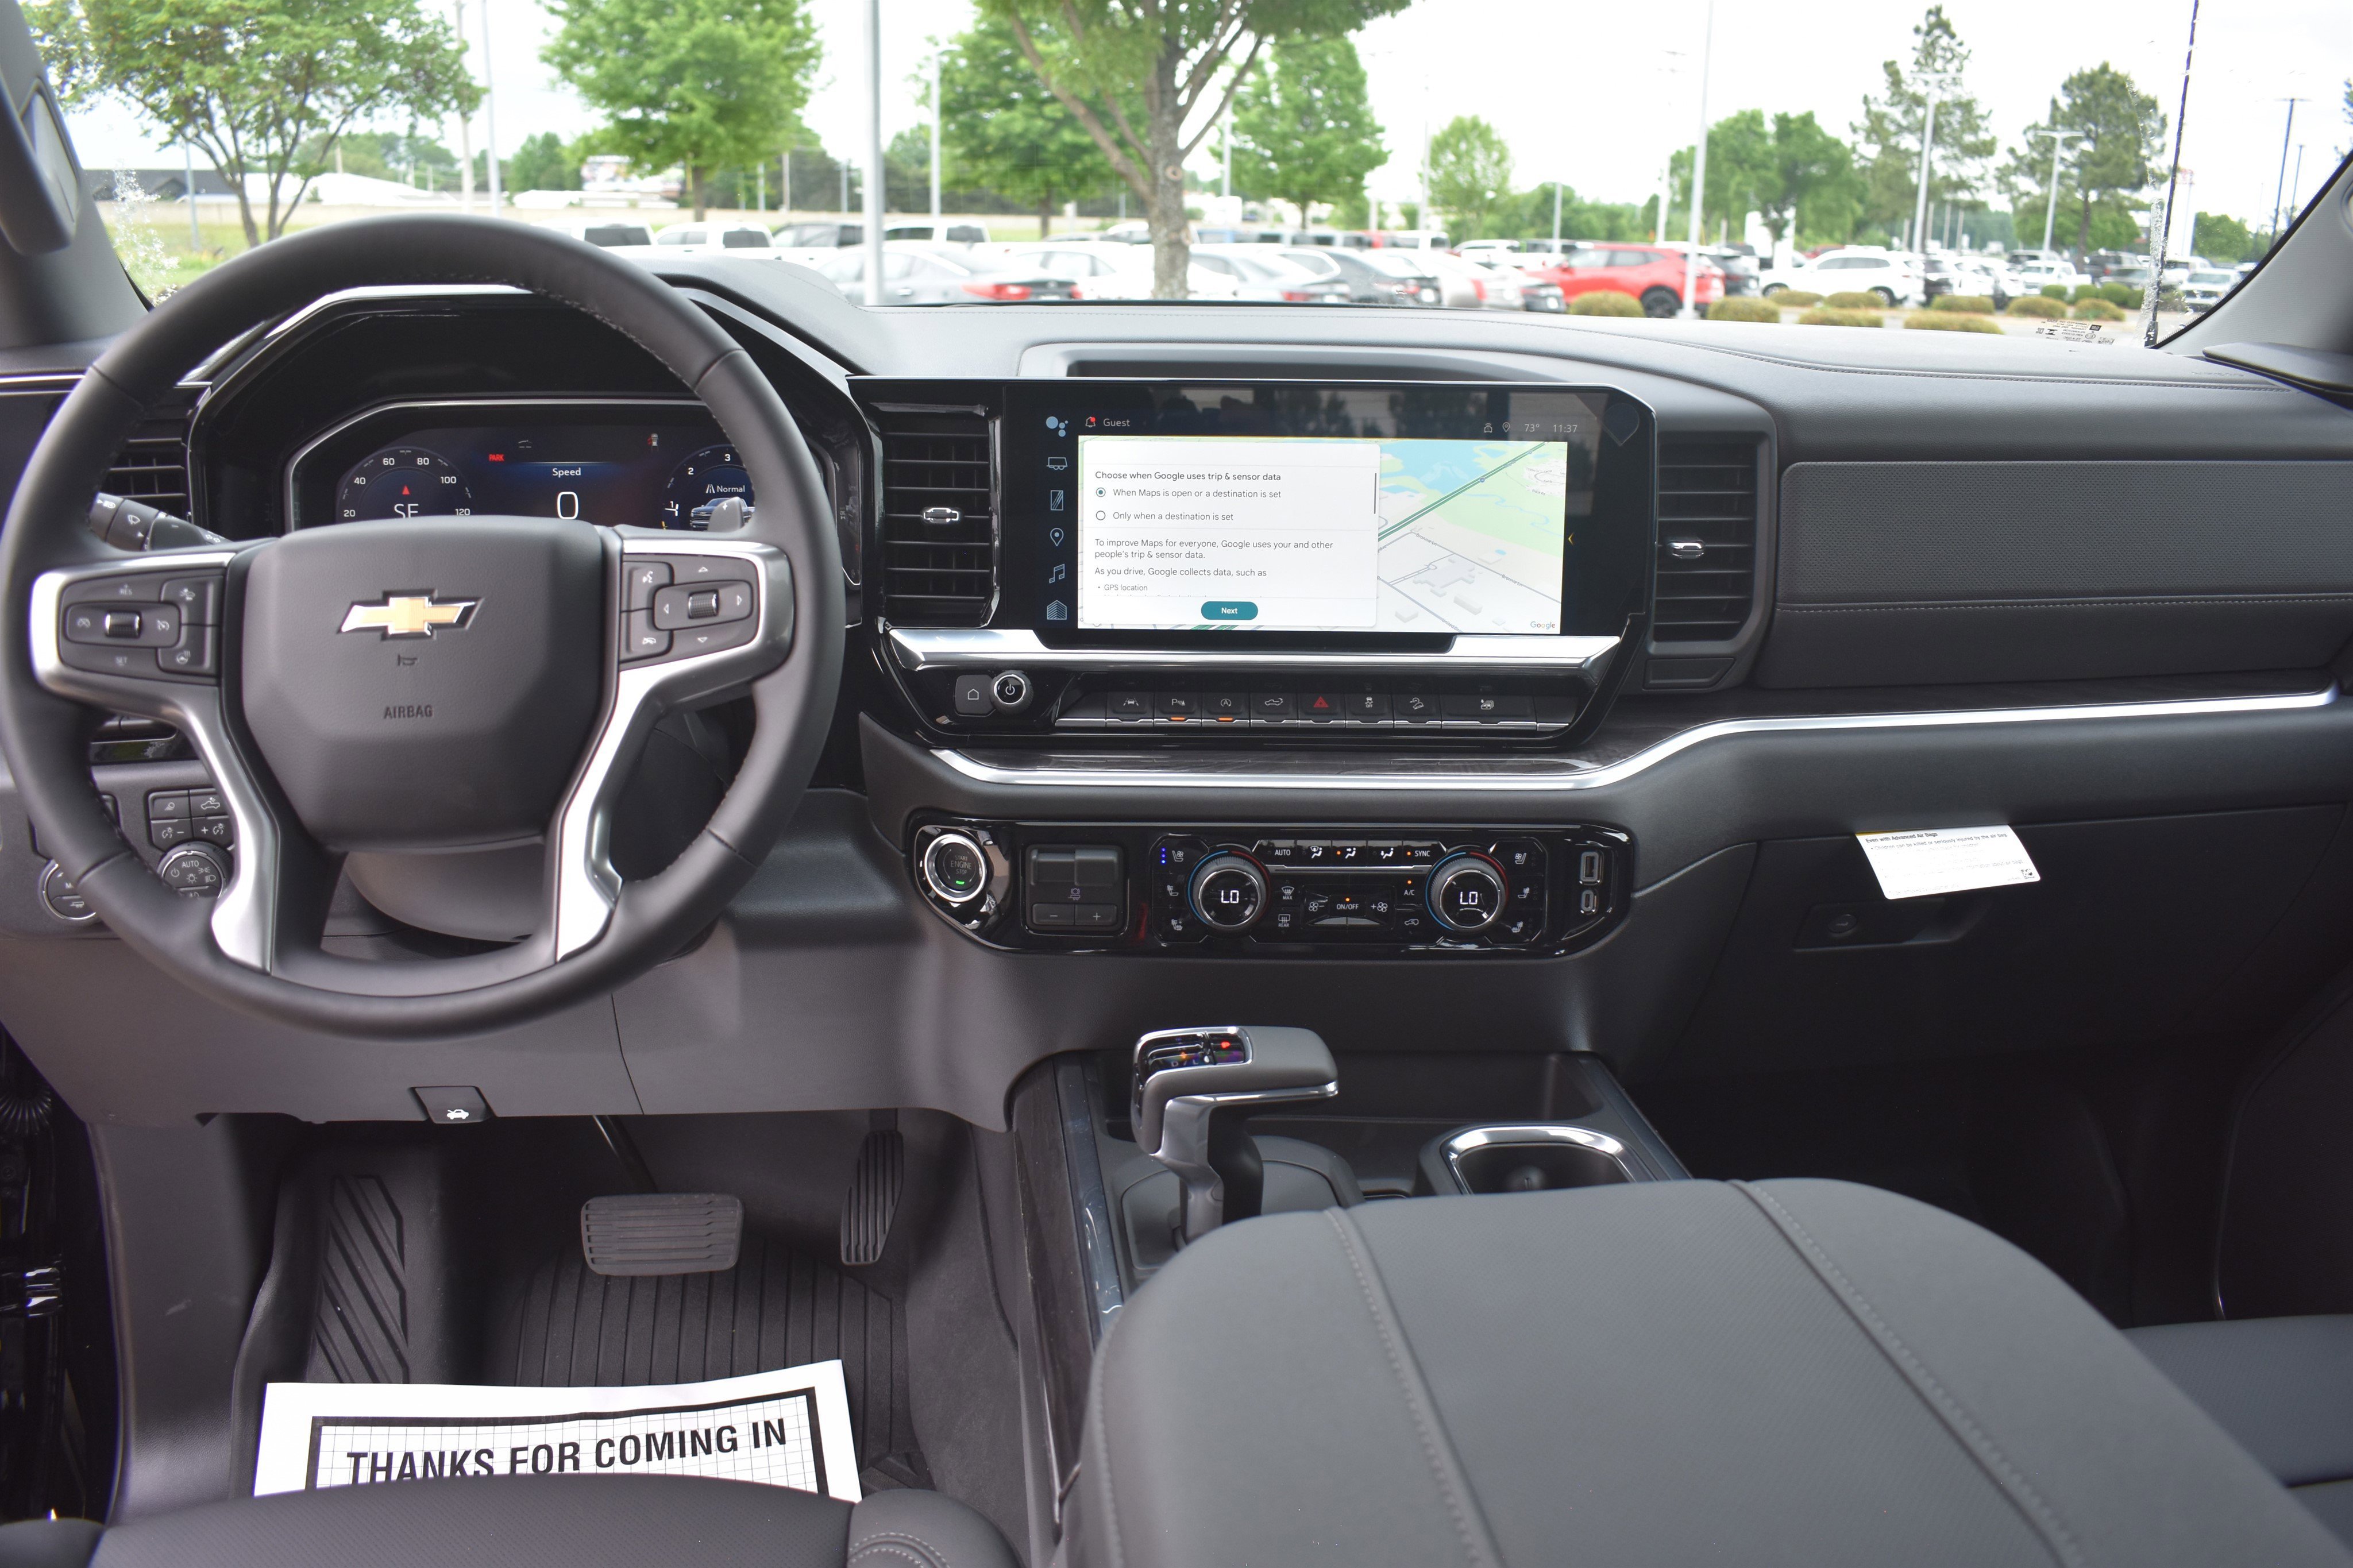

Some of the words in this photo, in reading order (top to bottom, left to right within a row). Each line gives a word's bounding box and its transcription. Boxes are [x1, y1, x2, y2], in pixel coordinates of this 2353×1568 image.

[1103, 418, 1130, 427] Guest
[1553, 424, 1577, 433] 11:37
[383, 458, 395, 466] 60
[417, 458, 430, 466] 80
[552, 467, 581, 478] Speed
[688, 467, 694, 475] 2
[354, 477, 367, 485] 40
[1155, 472, 1184, 481] Google
[1208, 473, 1222, 481] trip
[716, 485, 746, 493] Normal
[1139, 489, 1160, 497] Maps
[557, 491, 579, 520] 0
[344, 509, 356, 517] 20
[456, 508, 470, 516] 120
[1113, 512, 1131, 521] Only
[1107, 539, 1139, 547] improve
[1141, 539, 1163, 548] Maps
[1221, 540, 1250, 549] Google
[1096, 550, 1128, 559] people's
[1132, 551, 1144, 559] trip
[1124, 567, 1145, 576] drive,
[1148, 568, 1177, 577] Google
[1530, 621, 1556, 630] Google
[384, 705, 433, 719] AIRBAG
[950, 860, 972, 869] ENGINE
[347, 1447, 493, 1484] THANKS
[509, 1439, 580, 1474] FOR
[594, 1424, 738, 1468] COMING
[751, 1417, 787, 1448] IN
